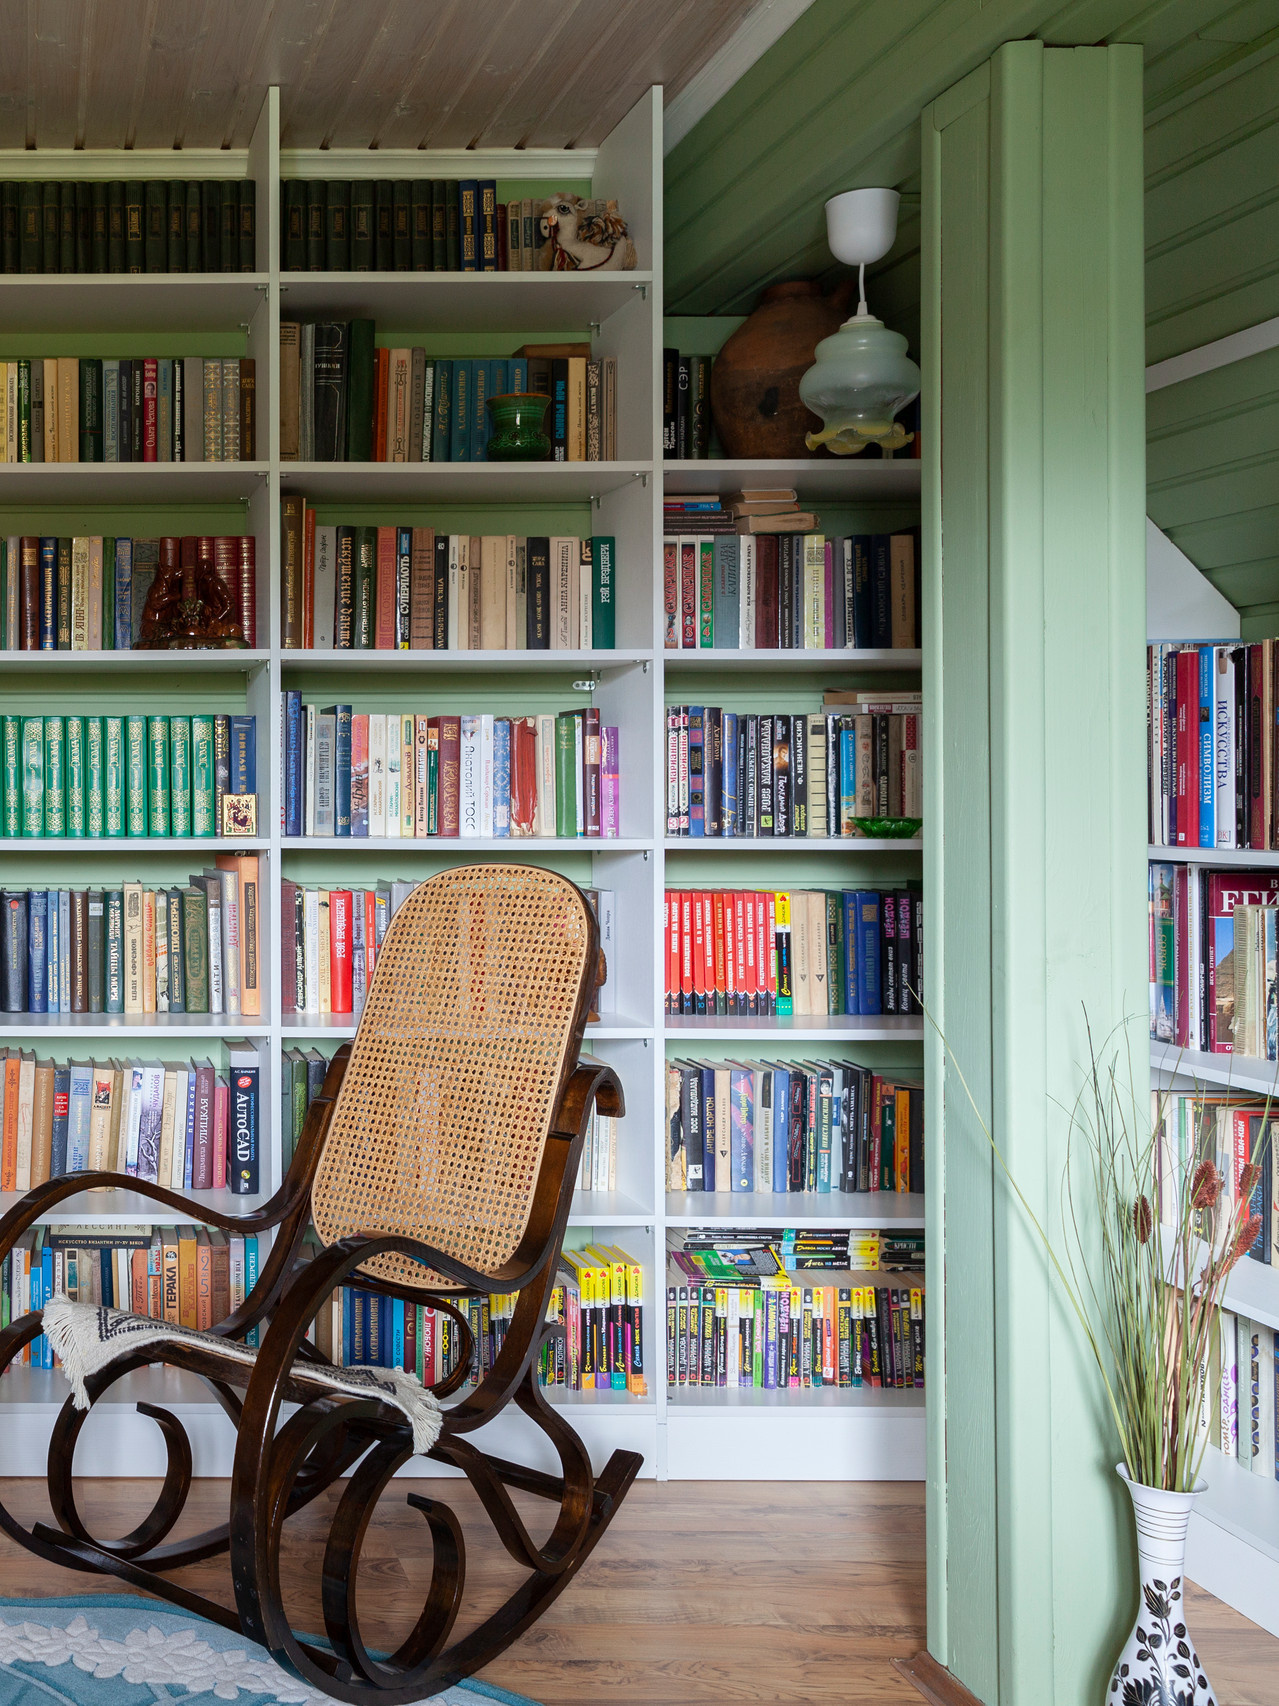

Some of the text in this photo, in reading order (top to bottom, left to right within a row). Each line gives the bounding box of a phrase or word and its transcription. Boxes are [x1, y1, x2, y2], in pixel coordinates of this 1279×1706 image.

[146, 401, 155, 447] Ольга Чехова
[555, 380, 565, 439] СЫНОВЬЯ НОЧИ
[600, 543, 611, 603] РЭЙ БРЭДБЕРИ
[720, 544, 728, 564] ДВА
[728, 544, 736, 594] КАПИТАНА
[339, 536, 353, 647] искушение данте
[400, 556, 410, 614] СУПЕРПЛОТЬ
[560, 591, 569, 614] АННА
[761, 719, 772, 812] РОСС МАКДОНАЛЬД
[795, 720, 804, 773] НЕЗНАНСКИЙ
[1204, 734, 1212, 805] СИМВОЛИЗМ
[1218, 701, 1228, 789] ИСКУССТВА
[352, 774, 364, 799] Грин
[608, 781, 616, 825] АЙЗЕК АЗИМОВ
[170, 897, 180, 953] ПИОНЕРЫ
[335, 898, 347, 958] РЭЙ БРЭДБЕРИ
[672, 923, 678, 931] НА
[110, 941, 120, 1001] ТАЙНЫ МОРЯ
[296, 971, 304, 1006] АЛЕКСАНДР
[887, 962, 895, 983] светят
[900, 963, 909, 1011] Конец света
[887, 984, 895, 1010] Звезды
[152, 1074, 160, 1108] ЧУДАКОВ
[198, 1098, 209, 1183] Людмила УЛИЦКАЯ
[690, 1117, 698, 1134] РОСС
[706, 1097, 715, 1154] АНДРЕ НОРТОН
[165, 1267, 177, 1309] ГЕРАКЛ
